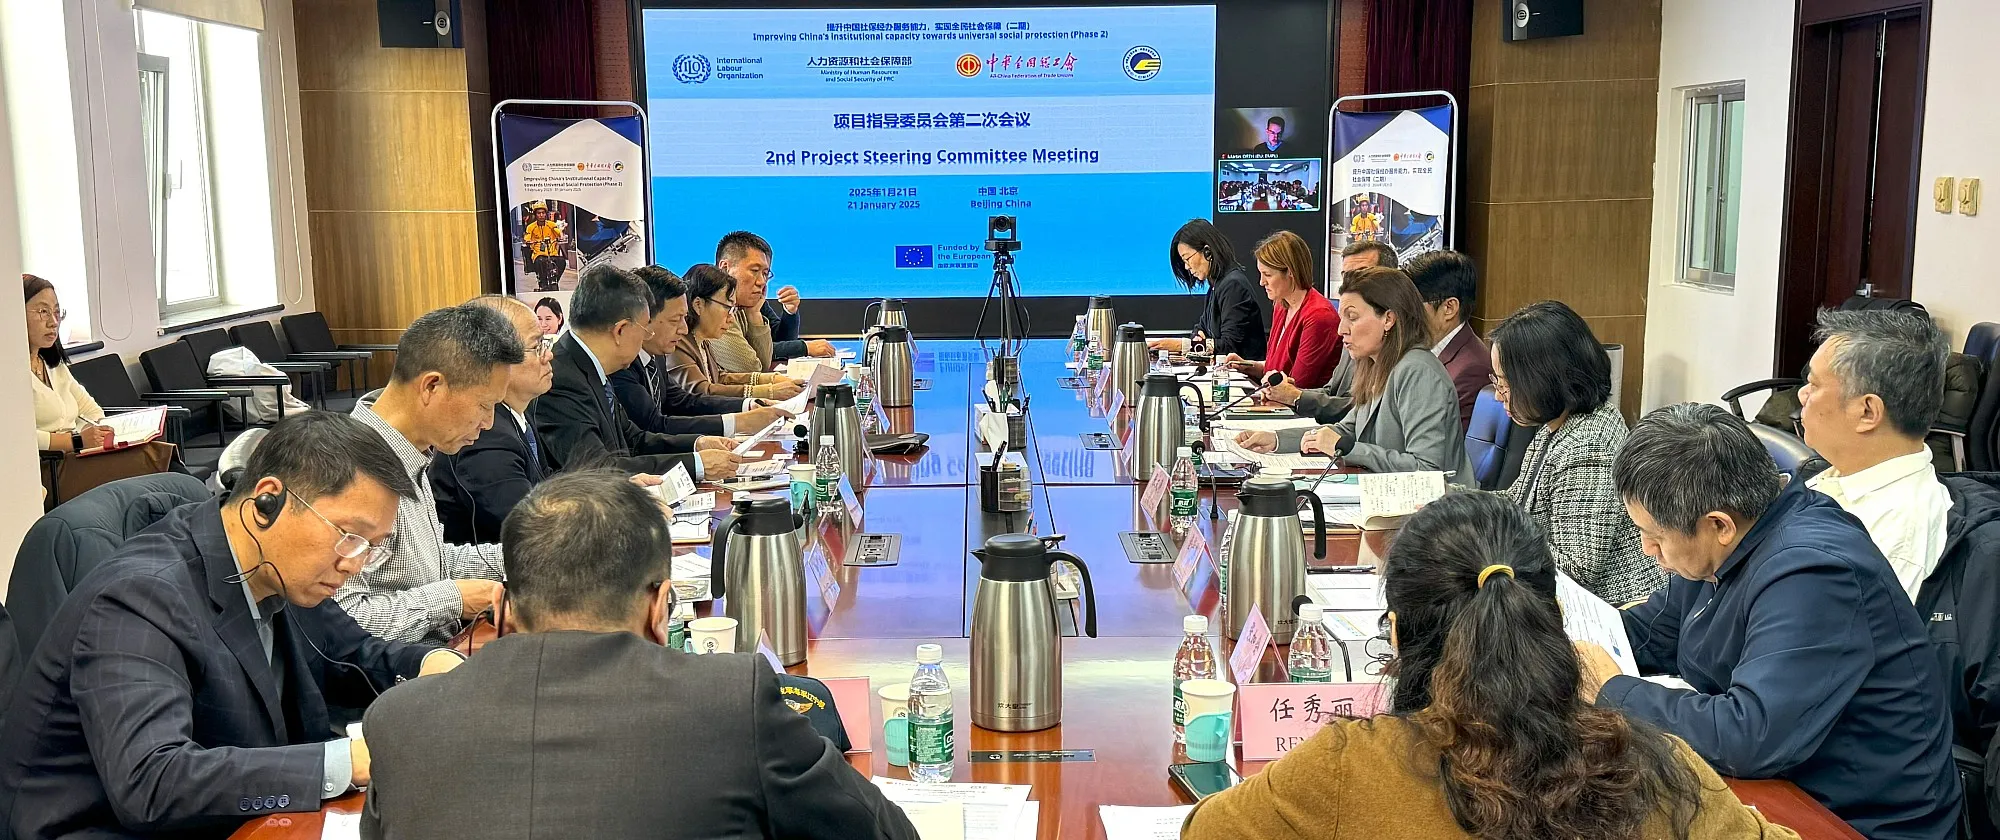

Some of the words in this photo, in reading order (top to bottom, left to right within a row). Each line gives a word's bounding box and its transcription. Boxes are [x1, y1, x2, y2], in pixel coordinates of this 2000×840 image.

[753, 33, 797, 42] Improving
[799, 33, 830, 41] China's
[885, 32, 920, 41] capacity
[922, 32, 956, 40] towards
[958, 32, 997, 40] universal
[999, 31, 1023, 40] social
[1025, 31, 1069, 40] protection
[1070, 31, 1099, 39] (Phase
[1100, 30, 1109, 39] 2)
[806, 56, 913, 66] 人力资源和社会保障部
[717, 72, 764, 80] Organization
[832, 111, 1031, 129] 项目指导委员会第二次会议
[765, 149, 796, 165] 2nd
[801, 149, 859, 166] Project
[863, 149, 932, 166] Steering
[936, 148, 1028, 164] Committee
[1032, 148, 1100, 164] Meeting
[848, 187, 918, 198] 2025年1月21日
[977, 186, 997, 197] 中国
[999, 186, 1019, 196] 北京
[847, 200, 858, 209] 21
[859, 200, 897, 211] January
[898, 199, 921, 209] 2025
[970, 198, 1003, 210] Beijing
[1005, 198, 1032, 209] China
[969, 244, 980, 252] by
[952, 253, 991, 261] European
[1269, 693, 1355, 724] 任秀丽
[1275, 736, 1304, 752] RE
